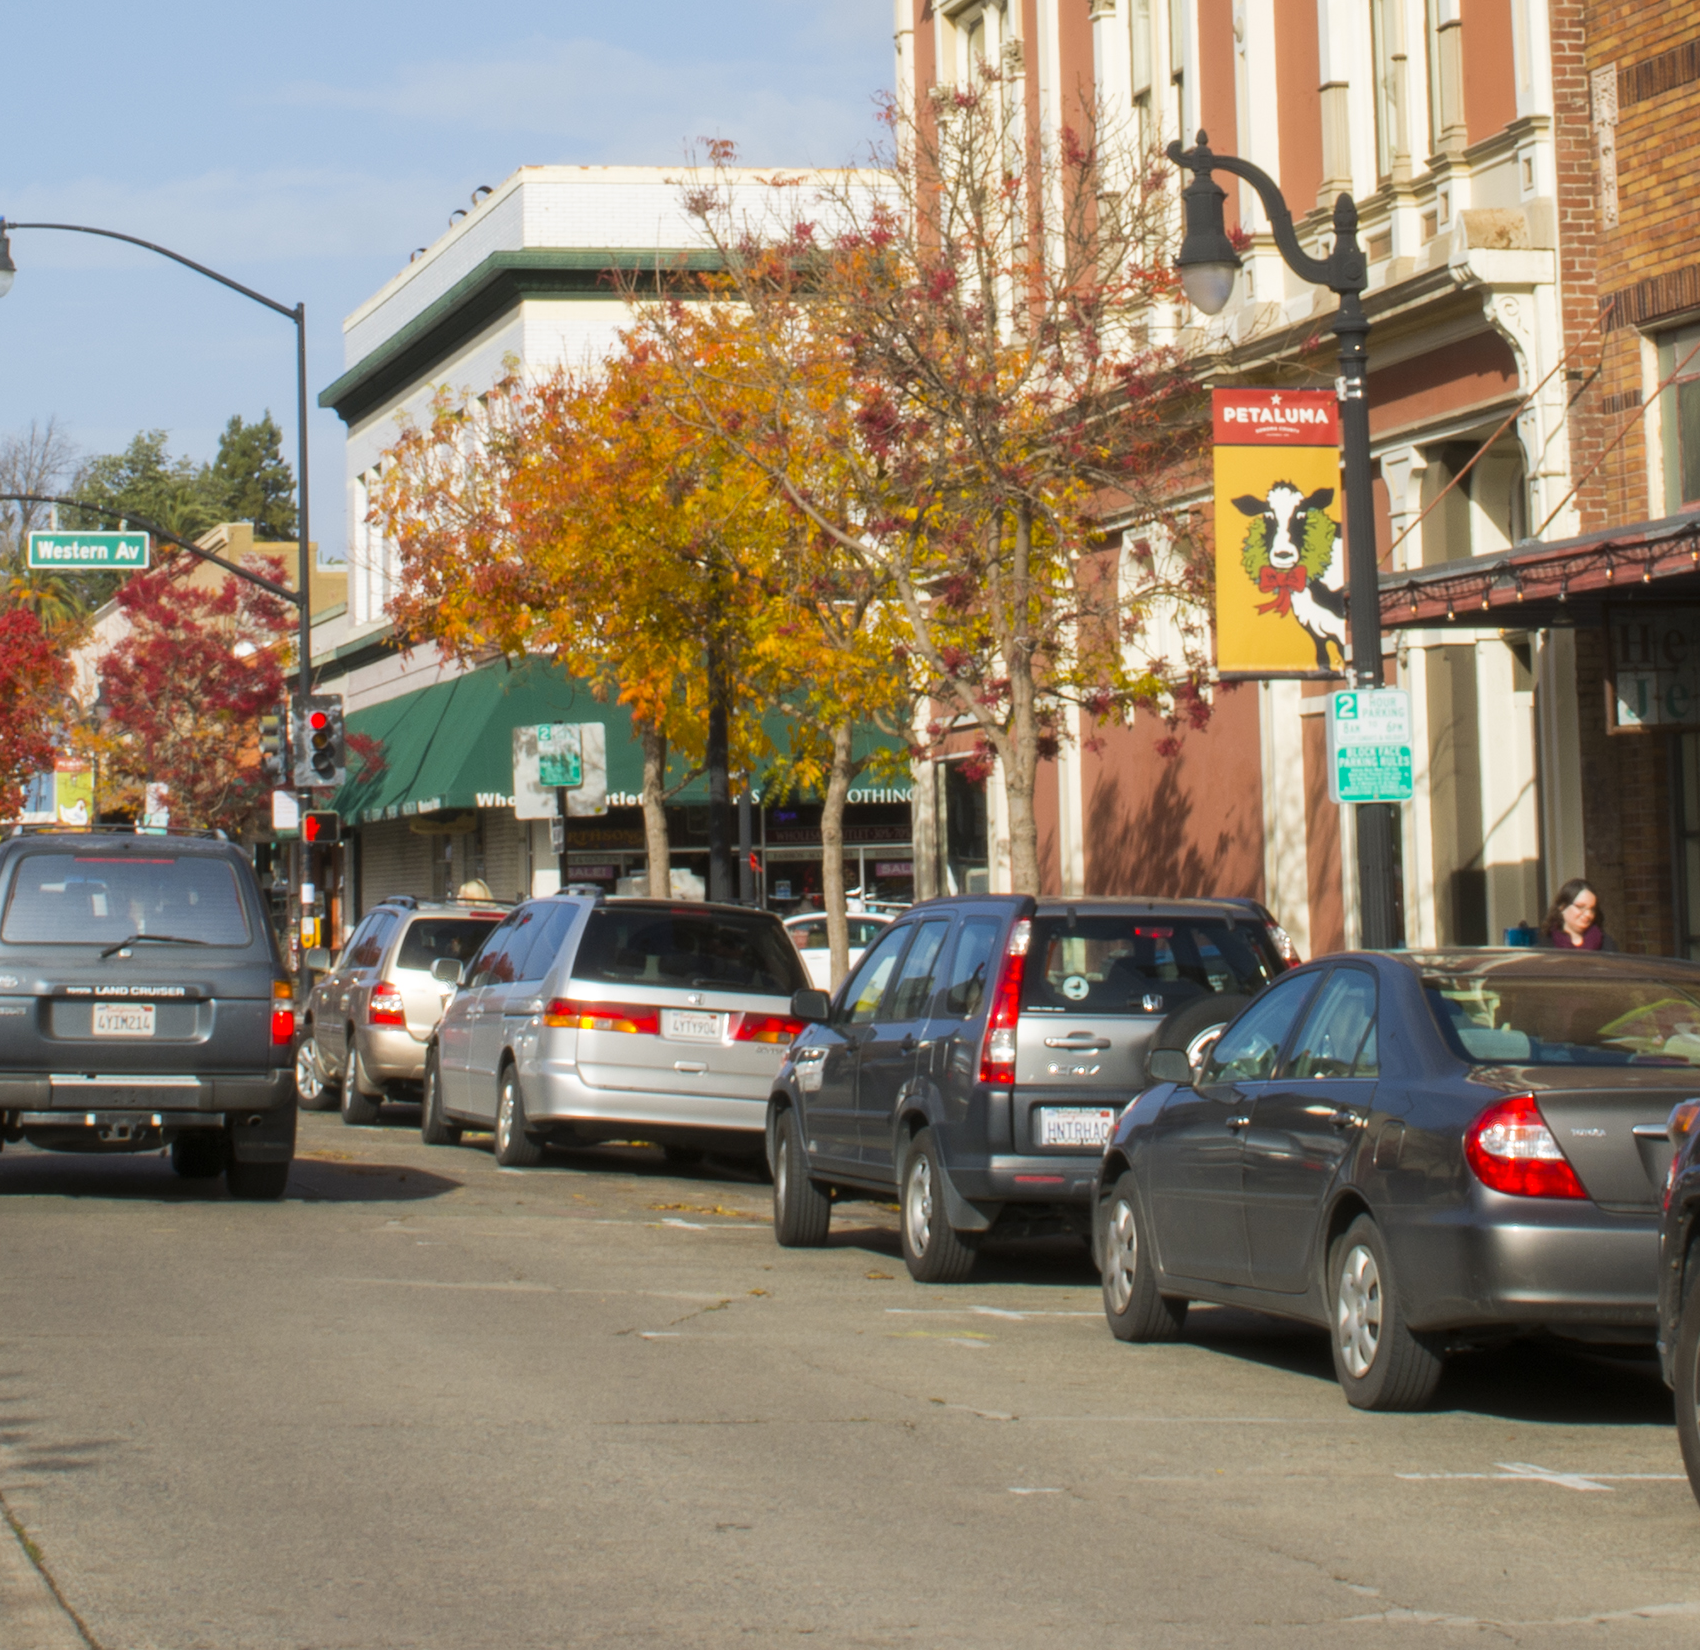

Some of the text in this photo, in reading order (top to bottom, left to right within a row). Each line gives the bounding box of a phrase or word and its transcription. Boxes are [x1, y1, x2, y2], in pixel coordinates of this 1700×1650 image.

[1223, 407, 1329, 424] PETALUMA
[37, 540, 140, 560] Western Av
[1338, 695, 1355, 718] 2
[1369, 697, 1396, 708] HOUR
[1362, 707, 1405, 718] PARKING
[540, 727, 550, 740] 2
[1340, 756, 1378, 767] PARKING
[94, 986, 129, 996] LAND
[130, 986, 185, 997] CRUISER
[98, 1015, 151, 1030] 4YIM214
